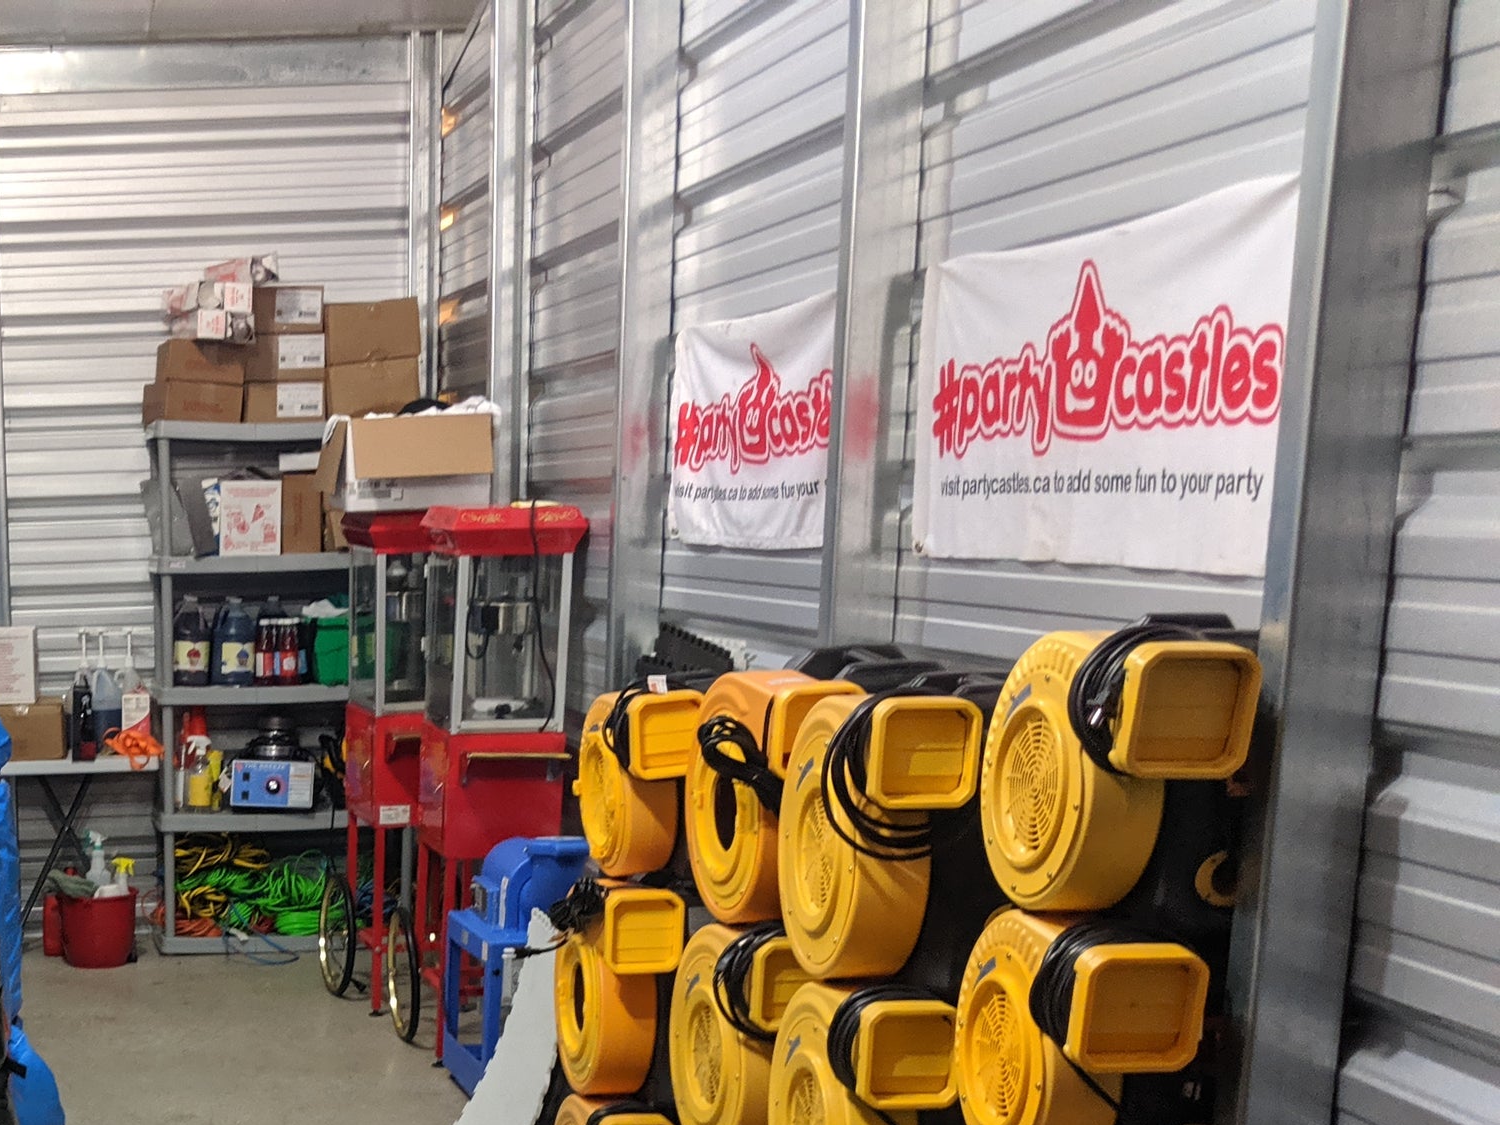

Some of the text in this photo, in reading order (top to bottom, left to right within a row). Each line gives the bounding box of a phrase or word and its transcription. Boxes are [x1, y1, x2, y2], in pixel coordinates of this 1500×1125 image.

[933, 305, 1284, 460] #party castles
[747, 483, 763, 501] add
[797, 478, 820, 501] your
[941, 467, 1264, 502] visit partycastles.ca to add some fun to your party
